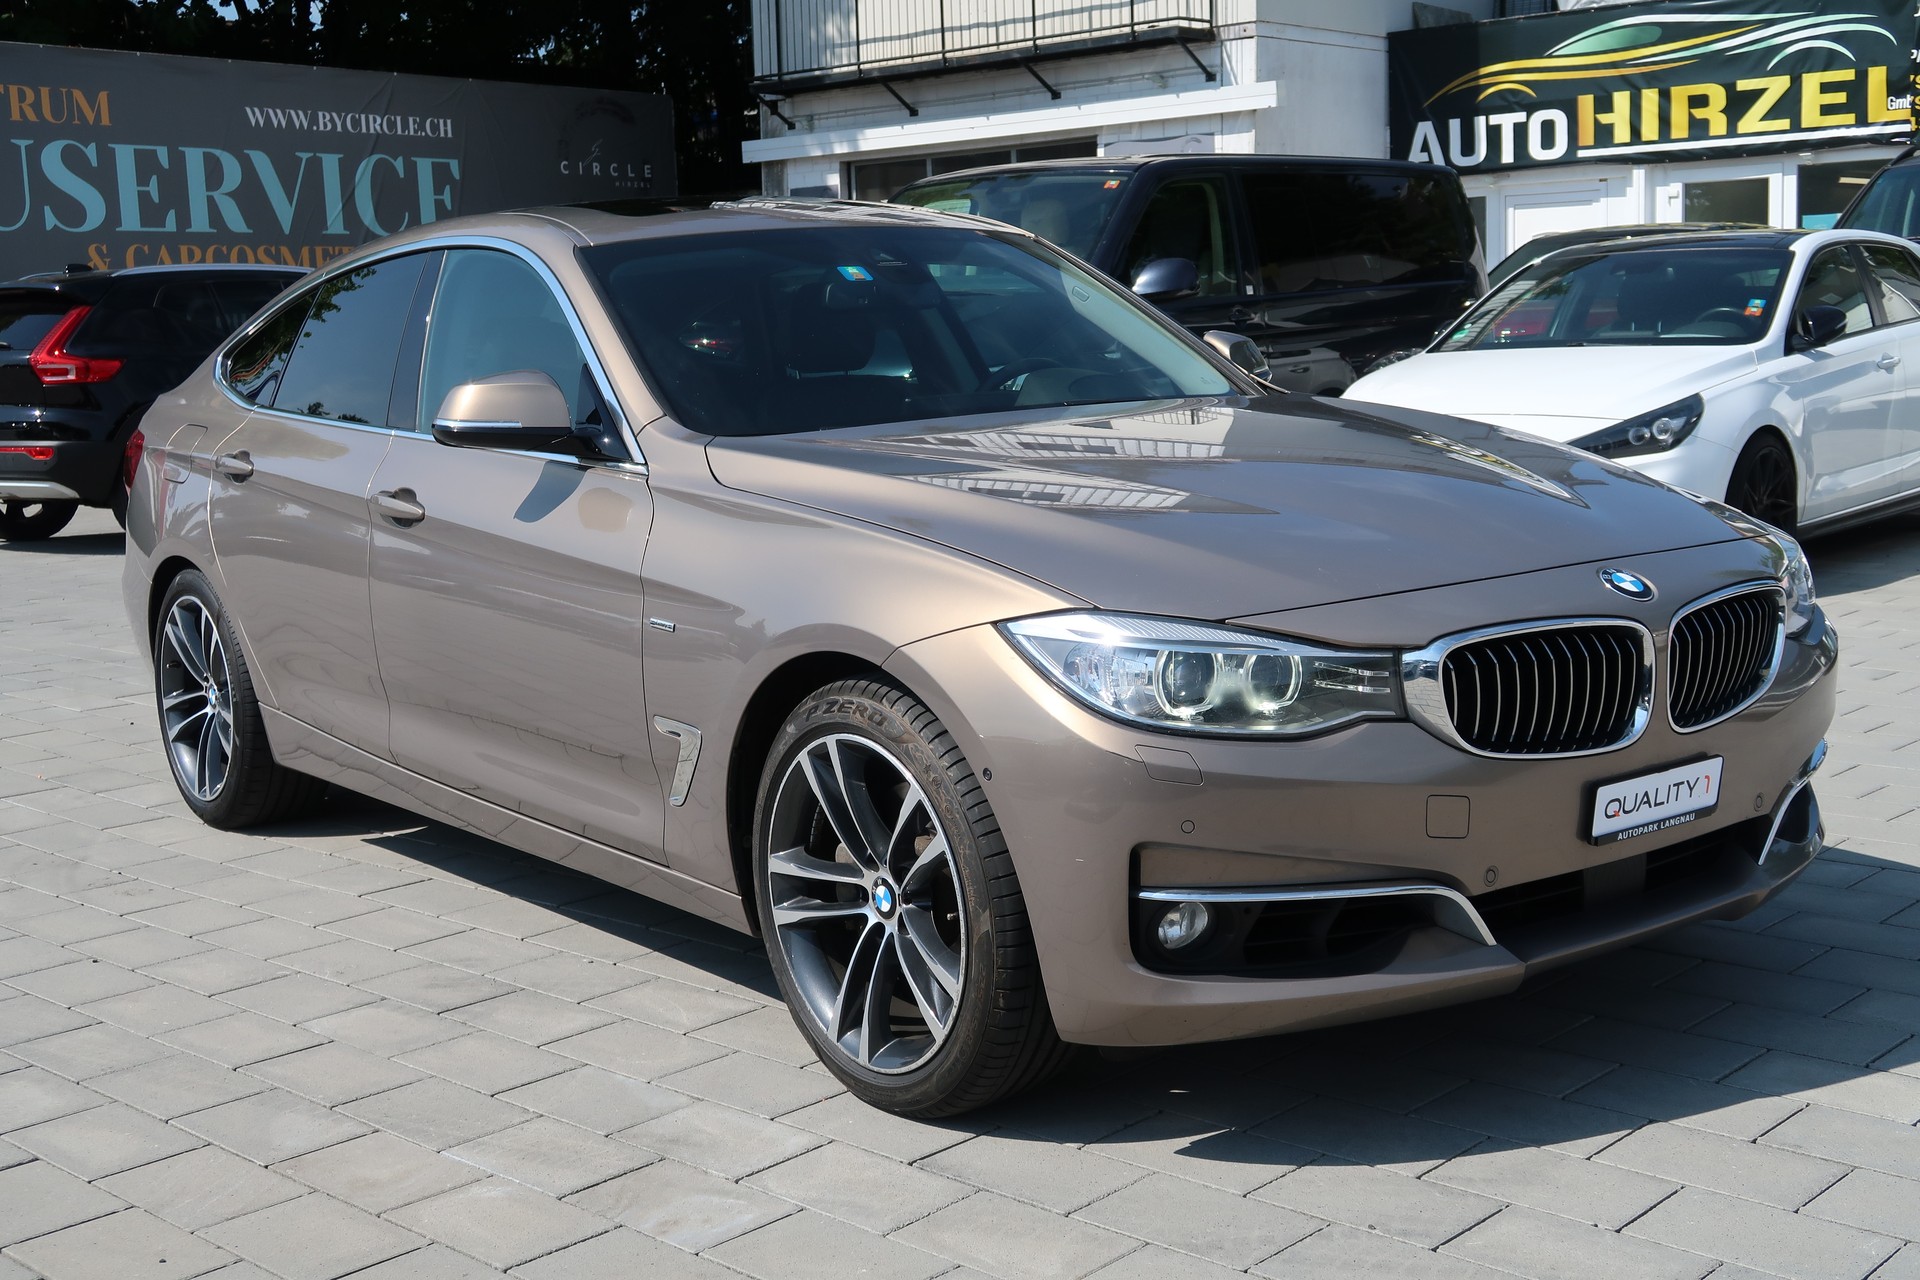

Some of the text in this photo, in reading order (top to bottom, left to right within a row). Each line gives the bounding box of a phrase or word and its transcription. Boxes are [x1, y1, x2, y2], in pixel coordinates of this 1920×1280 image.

[0, 84, 112, 126] RUM
[1408, 65, 1912, 167] AUTO HIRZEL
[244, 106, 453, 138] WWW.BYCIRCLE.CH
[560, 160, 652, 178] CIRCLE
[125, 244, 357, 269] CARCOSME
[1604, 775, 1711, 819] QUALITY 1
[1617, 812, 1696, 841] AUTOPARK LANGNAU
